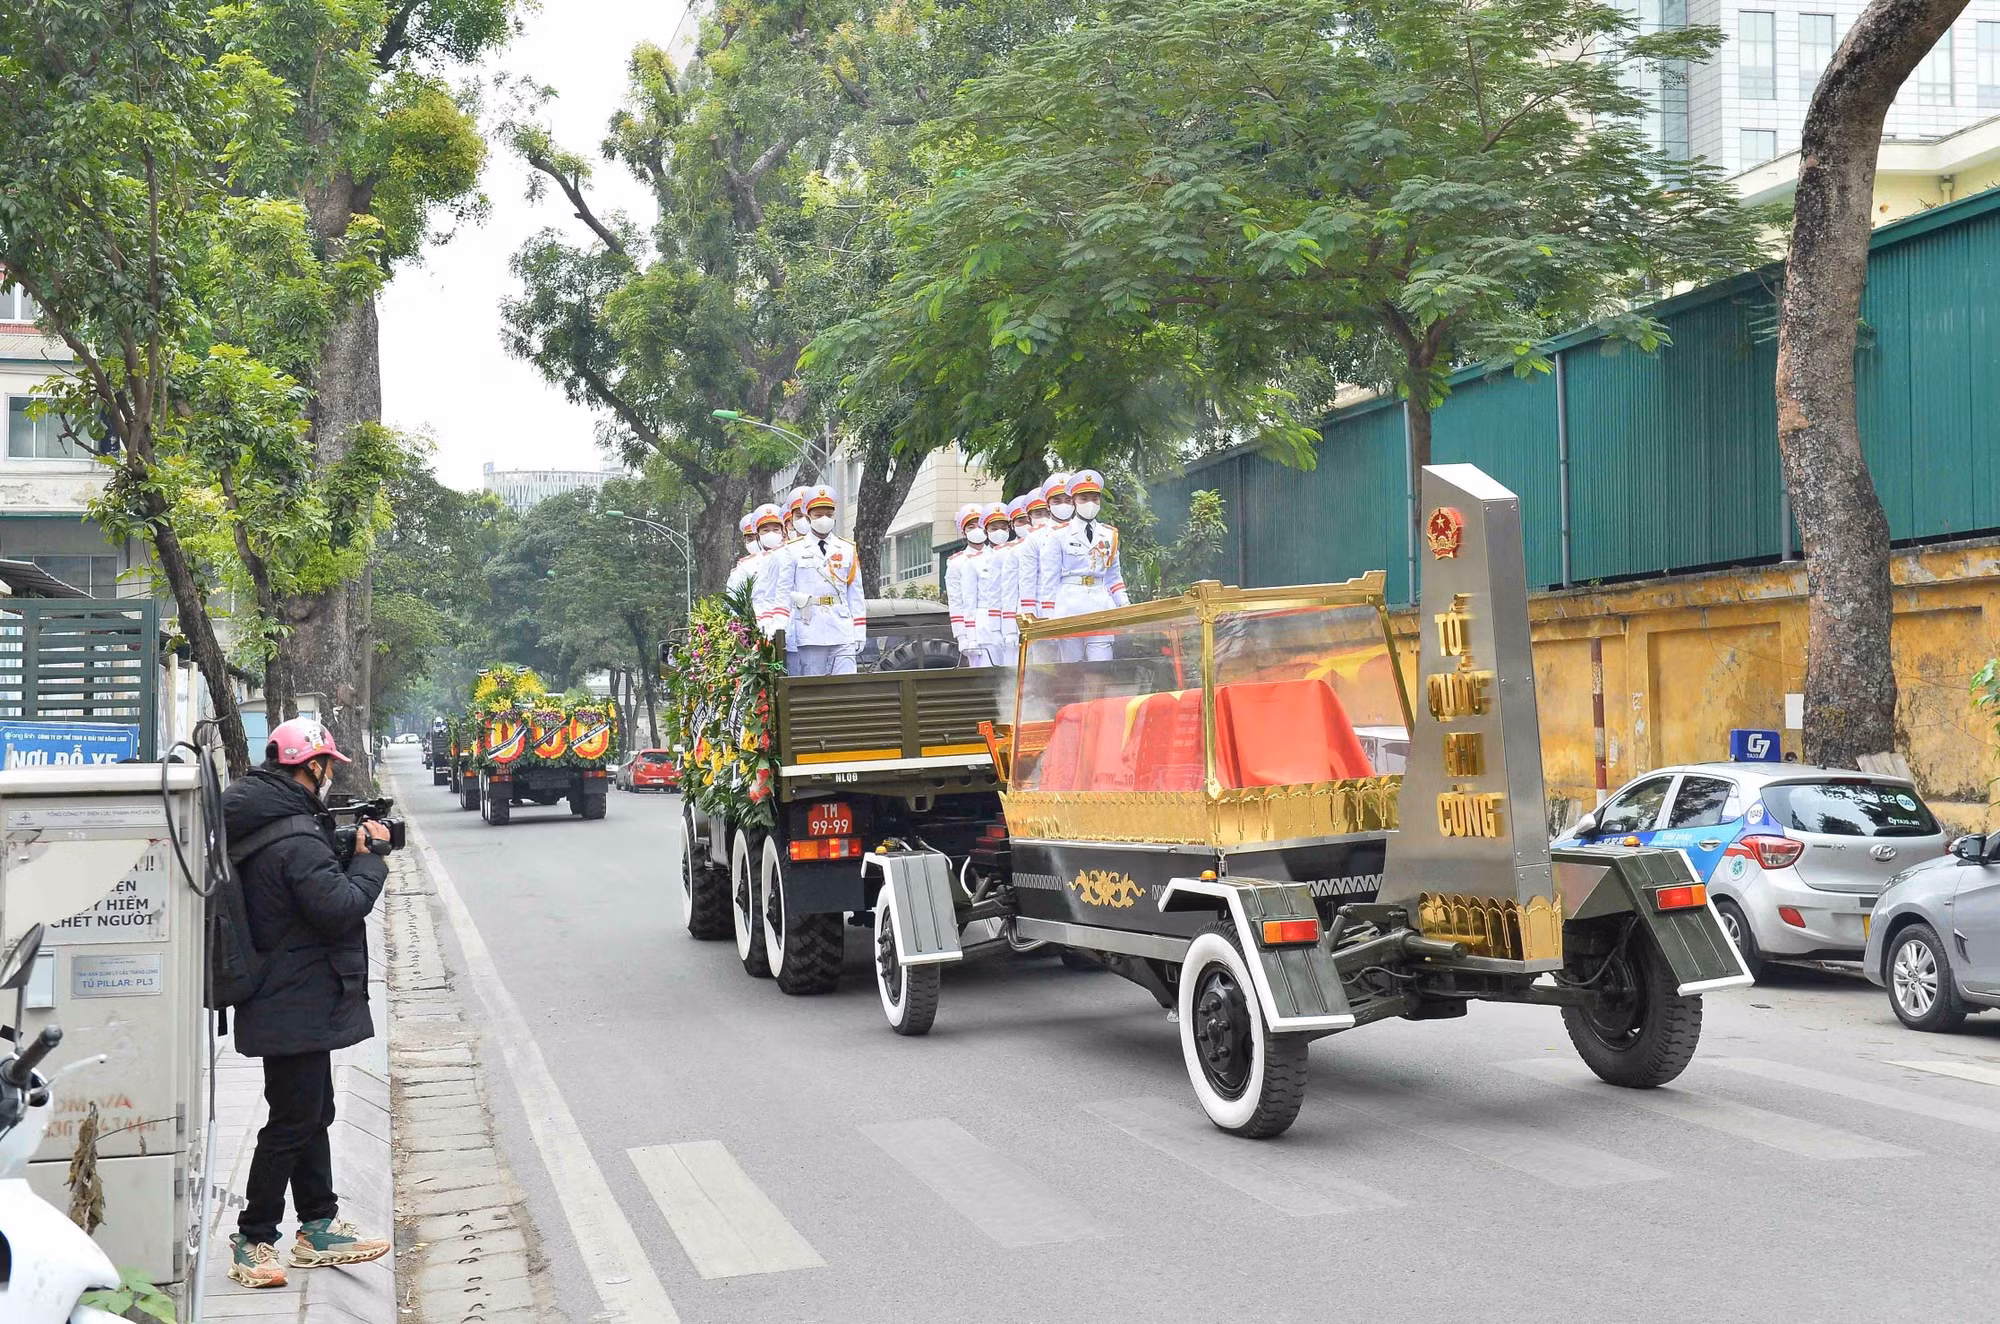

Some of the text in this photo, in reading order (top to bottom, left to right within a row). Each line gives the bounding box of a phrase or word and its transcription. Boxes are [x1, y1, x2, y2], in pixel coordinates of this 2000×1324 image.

[1748, 733, 1771, 759] G7
[1881, 795, 1897, 804] 32
[822, 803, 838, 818] TM
[1437, 784, 1498, 838] CÔNG
[812, 819, 849, 835] 99-99
[106, 895, 149, 911] HIỂM
[82, 978, 154, 989] TỦ PILLAR: PL3
